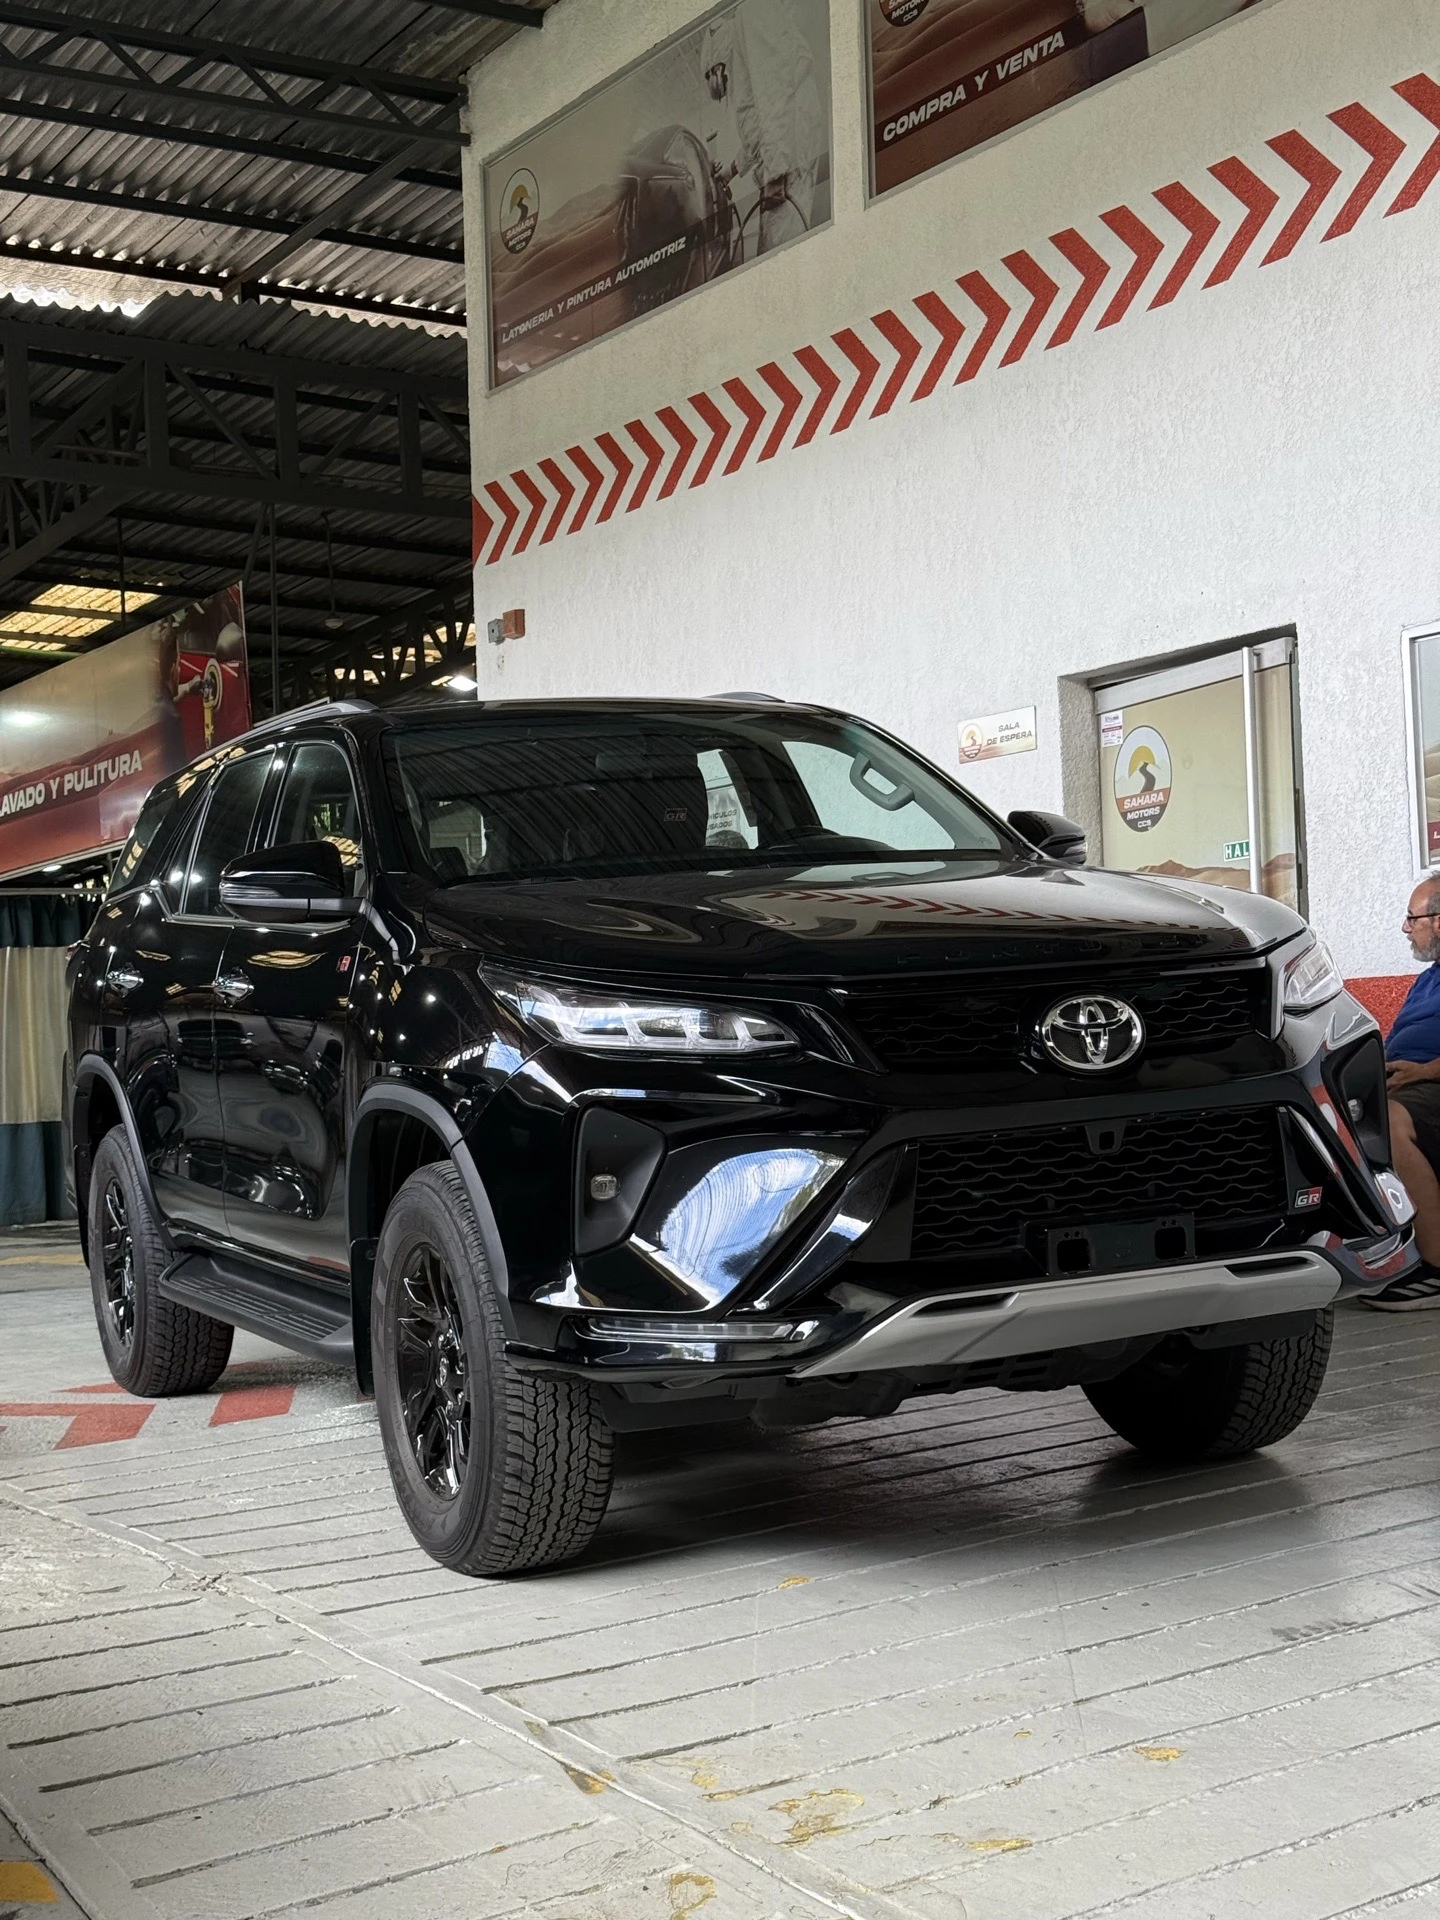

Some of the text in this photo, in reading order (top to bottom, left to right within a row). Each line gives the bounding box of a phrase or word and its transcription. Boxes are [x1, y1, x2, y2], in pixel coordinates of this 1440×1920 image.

[883, 30, 1065, 142] COMPRA Y VENTA
[502, 236, 687, 344] LATONERIA Y PINTURA AUTOMOTRIZ
[998, 721, 1020, 733] SALA
[986, 730, 1033, 746] DE ESPERA
[49, 777, 60, 800] Y
[64, 750, 143, 796] PULITURA
[1123, 791, 1165, 809] SAHARA
[1126, 806, 1161, 820] MOTORS
[1137, 819, 1152, 828] CCS
[1297, 1193, 1319, 1205] GR
